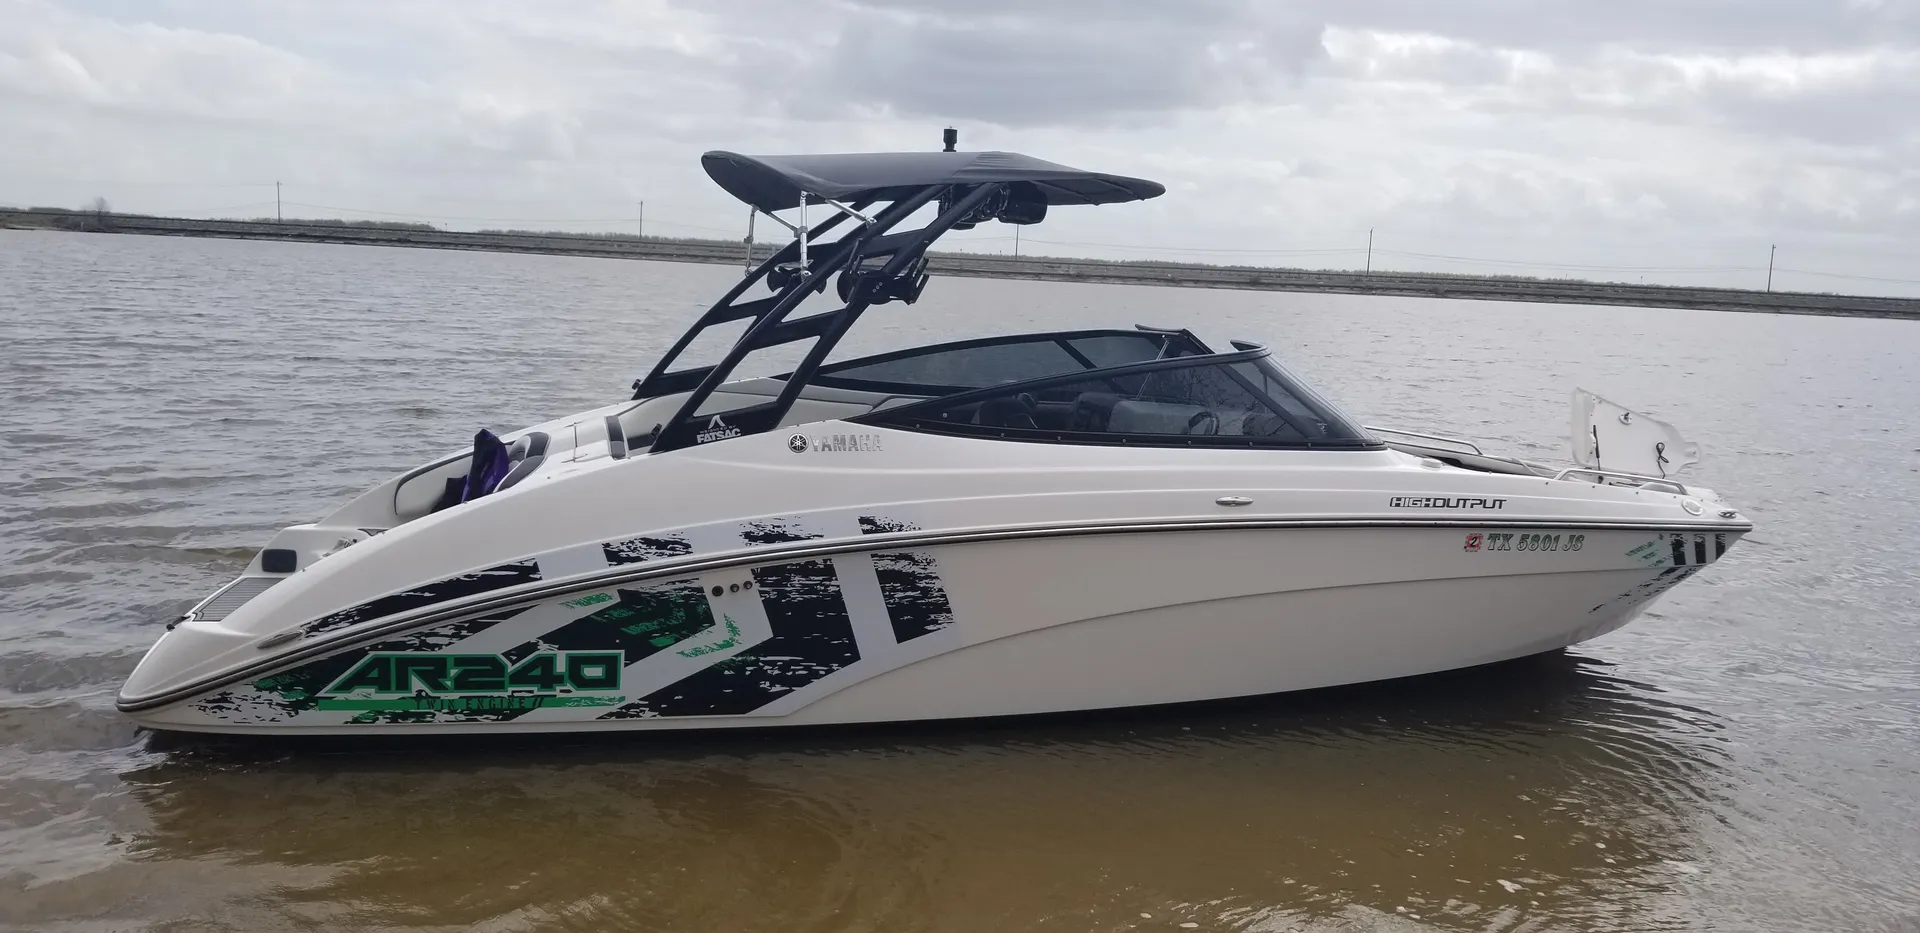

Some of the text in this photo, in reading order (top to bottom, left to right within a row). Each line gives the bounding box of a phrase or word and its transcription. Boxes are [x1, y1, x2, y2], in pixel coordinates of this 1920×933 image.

[696, 427, 741, 443] FATSAC
[809, 434, 883, 452] YAMAHA
[1487, 532, 1585, 551] TX 5801 JS
[321, 652, 622, 695] AR240
[414, 697, 526, 710] TWIN ENGINE
